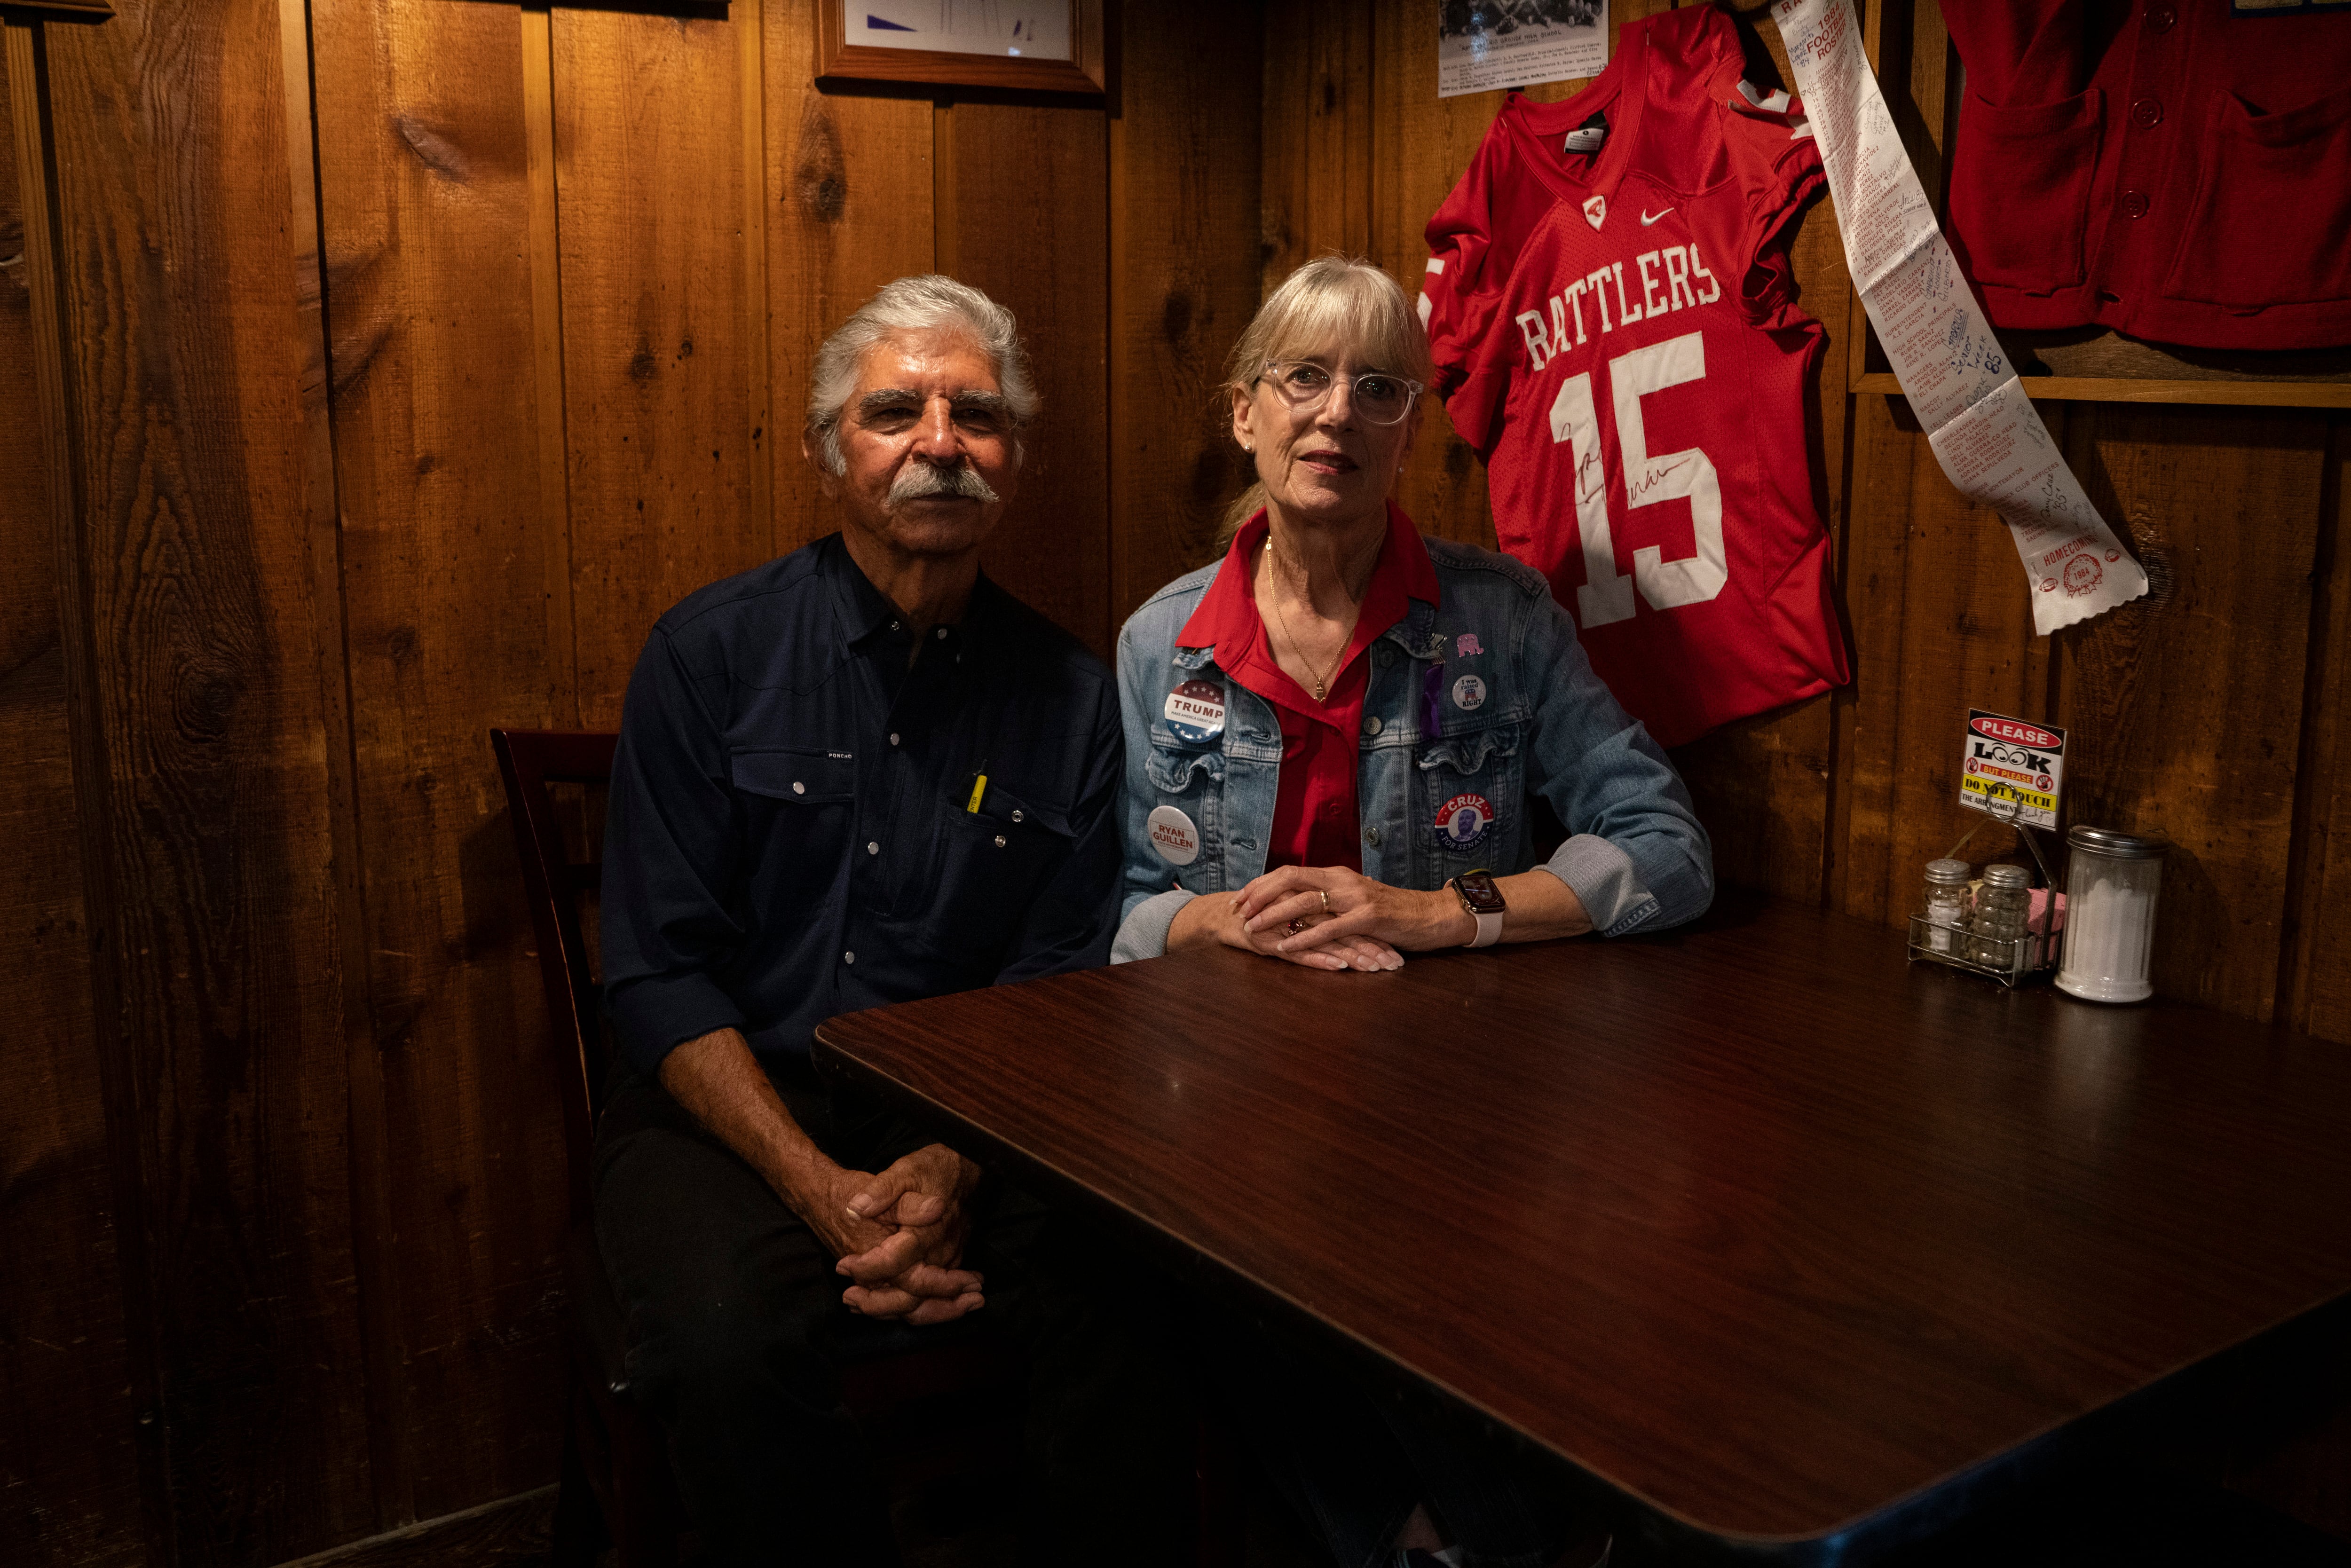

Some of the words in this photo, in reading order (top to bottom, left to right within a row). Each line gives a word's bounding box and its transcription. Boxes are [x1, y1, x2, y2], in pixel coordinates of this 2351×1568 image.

[1807, 3, 1846, 53] FOOTBALL
[1818, 1, 1839, 30] 1984
[1788, 33, 1814, 55] Margarito
[1817, 19, 1846, 60] ROSTER
[1854, 147, 1870, 164] GARCIA
[1855, 145, 1879, 171] BENAVIDEZ
[1854, 163, 1870, 180] GARCIA
[1859, 173, 1874, 188] PEREZ
[1847, 195, 1860, 212] ERASMO
[1862, 171, 1886, 194] MONTALVO
[1849, 203, 1867, 223] ENRIQUE
[1868, 186, 1887, 204] GUERRA
[1851, 208, 1870, 227] ANICETO
[1870, 182, 1900, 209] VILLARREAL
[1857, 182, 1881, 206] LAGRANGE
[1853, 220, 1866, 233] DAVID
[1854, 221, 1873, 239] ARTHUR
[1874, 199, 1899, 221] VALVERDE
[1856, 230, 1874, 245] LEONEL
[1875, 215, 1889, 229] SOLIS
[1859, 229, 1883, 250] TEODULFO
[1884, 213, 1902, 229] RIVERA
[1861, 234, 1886, 257] BALDEMAR
[1887, 220, 1902, 235] PEREZ
[1857, 254, 1880, 275] ATHLETIC
[1882, 232, 1906, 254] DIRECTOR
[1864, 260, 1882, 277] RAMIRO
[1884, 241, 1906, 260] VILLEGAS
[1864, 267, 1893, 292] ASSISTANTS
[1871, 279, 1887, 294] JESSIE
[1887, 262, 1908, 282] SALINAS
[1873, 290, 1883, 300] PAT
[1885, 276, 1901, 291] SAENZ
[1515, 243, 1721, 372] RATTLERS
[1877, 280, 1907, 306] CANDELARIO
[1879, 297, 1895, 312] DANNY
[1897, 276, 1919, 297] VASQUEZ
[1882, 300, 1901, 317] DARREL
[1902, 280, 1925, 301] EARHART
[1884, 304, 1907, 323] RICARDO
[1908, 289, 1924, 305] LOPEZ
[1885, 302, 1927, 338] SUPERINTENDENT
[1893, 331, 1904, 339] A.E.
[1905, 313, 1925, 330] GARCIA
[1893, 343, 1906, 355] HIGH
[1907, 328, 1926, 345] SCHOOL
[1928, 302, 1957, 328] PRINCIPALS
[1901, 342, 1917, 357] RUBEN
[1918, 329, 1935, 343] SAENZ
[1904, 354, 1913, 363] JOE
[1921, 329, 1945, 349] SANCHEZ
[1906, 356, 1919, 369] RENE
[1906, 362, 1933, 384] MANAGERS
[1914, 366, 1937, 386] ARNOLDO
[1939, 352, 1958, 367] ALANIZ
[1917, 378, 1932, 392] JAIME
[1933, 363, 1951, 380] ALANIZ
[1919, 389, 1928, 398] ELI
[1929, 376, 1947, 390] CHAPA
[1919, 395, 1940, 413] MASCOT
[1928, 401, 1943, 415] SALLY
[1946, 383, 1969, 402] ALVAREZ
[1930, 419, 1943, 429] YELL
[1944, 404, 1964, 420] LEADER
[1943, 433, 1967, 450] BELINDA
[1969, 406, 2004, 433] LANDIN-HEAD
[1937, 418, 1976, 447] CHEERLEADERS
[1947, 443, 1963, 456] CINDY
[1965, 424, 1991, 443] PALACIOS
[1953, 456, 1968, 467] ALMA
[2001, 422, 2017, 434] HEAD
[1965, 433, 1989, 452] ALVAREZ
[1957, 457, 1979, 473] AURORA
[1980, 434, 2011, 458] RODRIGUEZ
[1960, 461, 1984, 480] ADRIANA
[1985, 439, 2016, 463] RODRIGUEZ
[1964, 472, 1980, 485] DIANA
[1981, 451, 2012, 473] SEPULVEDA
[1549, 331, 1728, 630] 15
[2015, 481, 2030, 492] CLUB
[2031, 462, 2059, 482] OFFICERS
[2026, 529, 2045, 543] SABINO
[2043, 534, 2099, 567] HOMECOMING
[2074, 567, 2090, 580] 1984
[1174, 700, 1223, 718] TRUMP
[1462, 699, 1482, 707] RIGHT
[1981, 720, 2049, 745] PLEASE
[1974, 741, 2051, 775] LOOK
[1983, 766, 1999, 775] BUT
[2002, 770, 2032, 784] PLEASE
[1448, 795, 1485, 811] CRUZ
[1962, 793, 1973, 802] THE
[1974, 797, 2017, 814] ARRNGMENT
[1965, 778, 1980, 790] DO
[1982, 783, 2007, 797] NOT
[2009, 788, 2051, 808] TOUCH
[1153, 832, 1193, 849] GUILLEN
[1159, 825, 1184, 838] RYAN
[1442, 836, 1456, 849] FOR
[1458, 831, 1488, 850] SENATE
